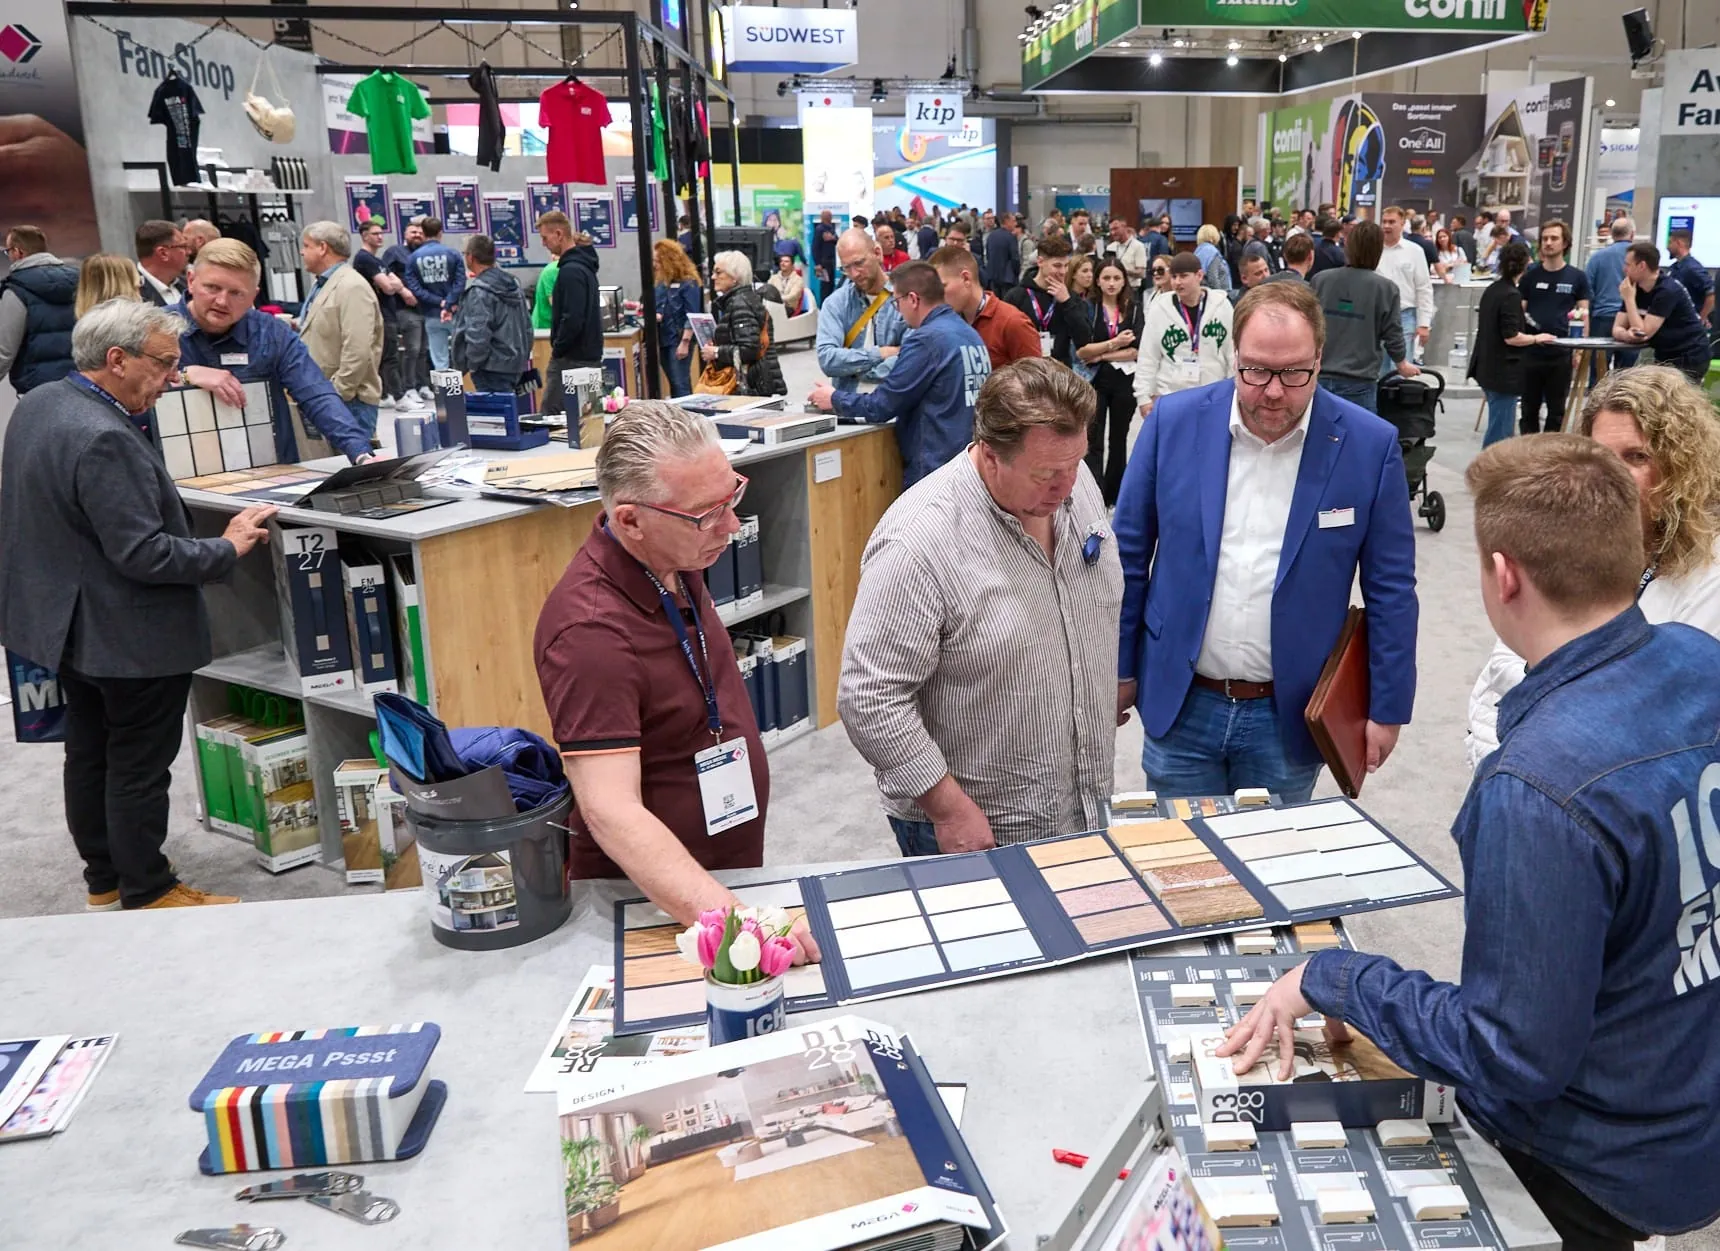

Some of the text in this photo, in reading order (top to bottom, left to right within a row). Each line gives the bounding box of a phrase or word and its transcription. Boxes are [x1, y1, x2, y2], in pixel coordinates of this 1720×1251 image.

[746, 25, 845, 44] SÜDWEST
[915, 98, 956, 126] kip
[1399, 137, 1421, 149] One
[1425, 137, 1441, 149] All
[960, 344, 993, 375] ICH
[447, 385, 462, 395] 28
[296, 534, 325, 552] T2
[298, 550, 326, 571] 27
[746, 1007, 787, 1038] ICH
[236, 1048, 398, 1074] MEGA Pssst
[565, 1041, 609, 1060] 28
[804, 1041, 857, 1071] 28
[868, 1040, 904, 1061] 28
[557, 1056, 600, 1075] RE
[572, 1087, 616, 1106] DESIGN
[1211, 1093, 1239, 1123] D3
[1237, 1091, 1265, 1124] 28
[850, 1212, 900, 1230] MEGA
